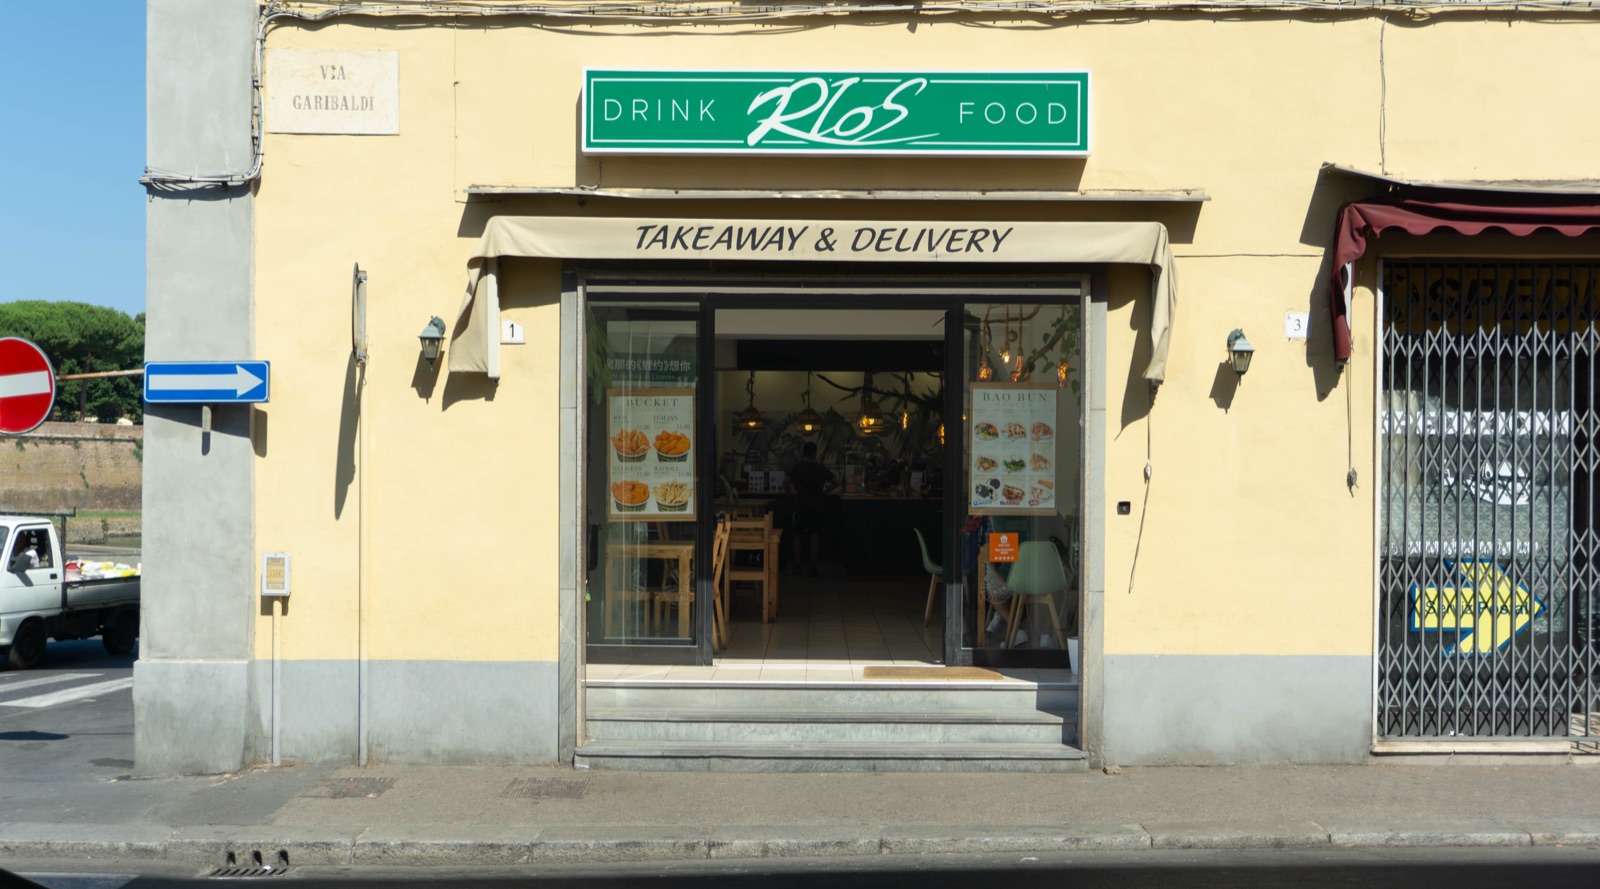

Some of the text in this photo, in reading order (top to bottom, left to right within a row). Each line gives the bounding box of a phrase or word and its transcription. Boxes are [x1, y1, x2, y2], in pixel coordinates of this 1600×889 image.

[320, 65, 346, 80] VIA
[292, 95, 375, 112] GARIBALDI
[603, 98, 717, 122] DRINK
[958, 101, 1067, 125] FOOD
[635, 224, 1014, 253] TAKEAWAY & DELIVERY
[509, 323, 515, 338] 1
[1294, 318, 1301, 331] 3
[626, 398, 679, 407] BUCKET
[983, 392, 1048, 402] BAO BUN
